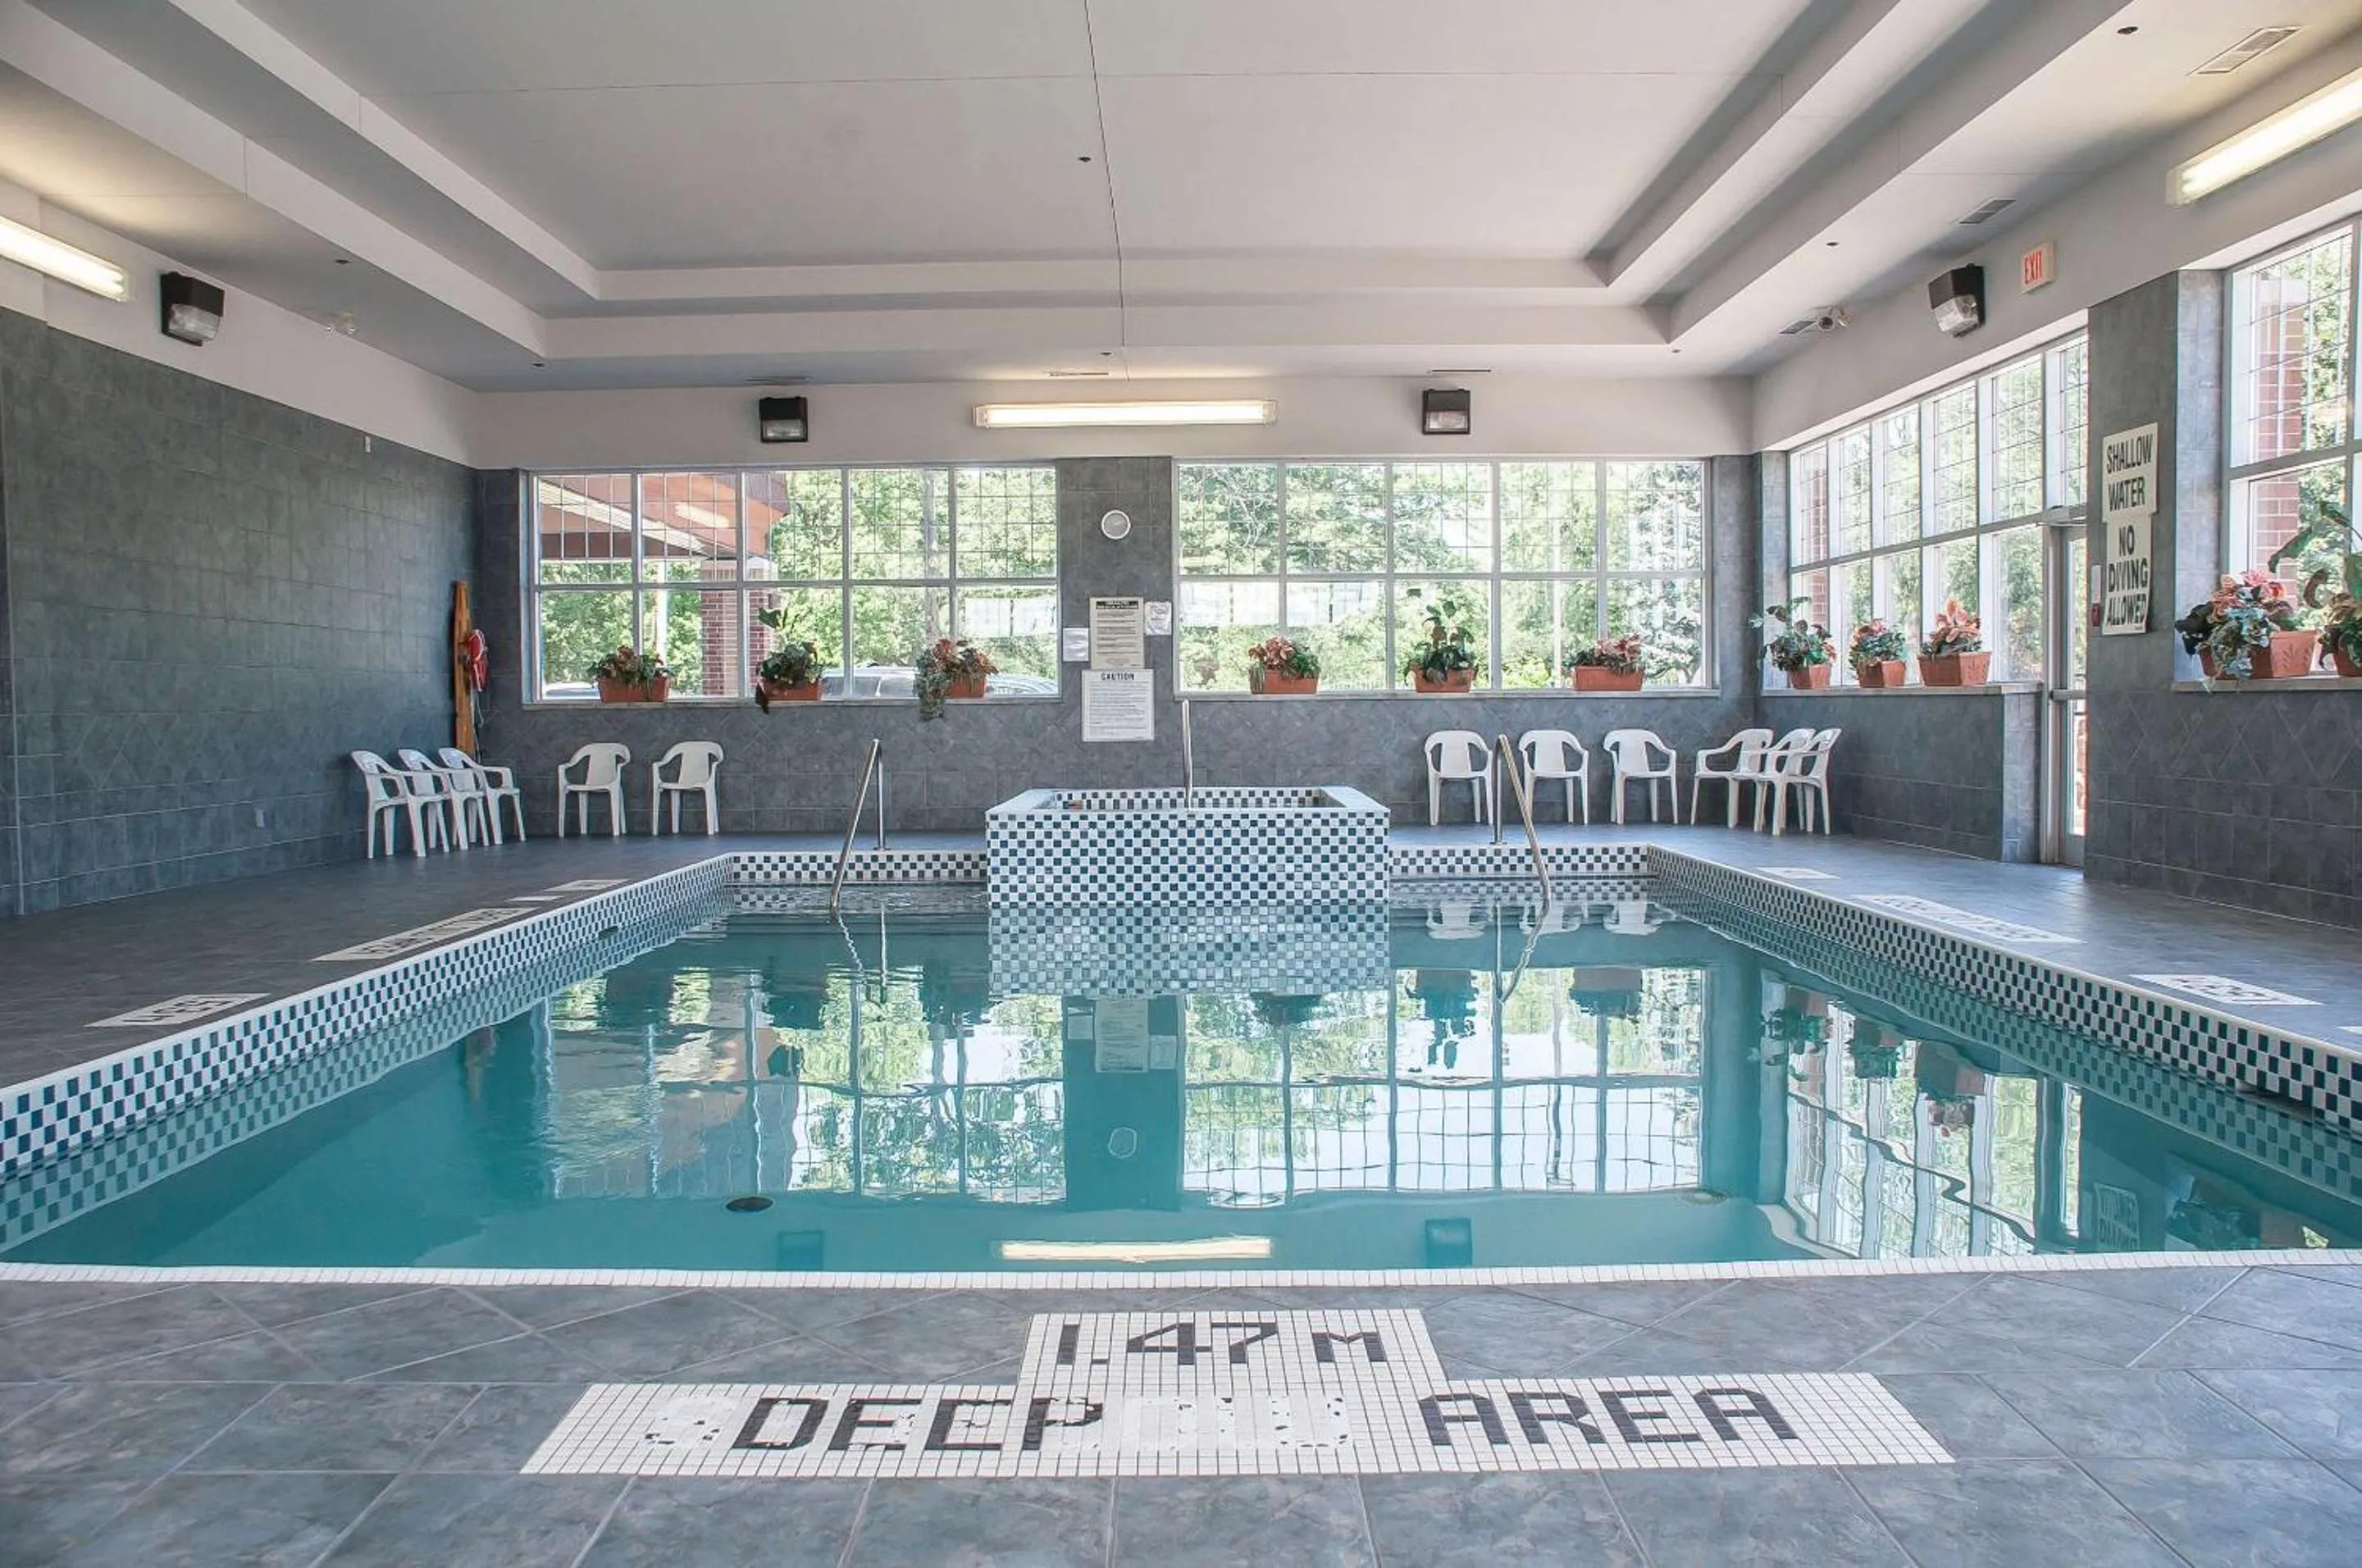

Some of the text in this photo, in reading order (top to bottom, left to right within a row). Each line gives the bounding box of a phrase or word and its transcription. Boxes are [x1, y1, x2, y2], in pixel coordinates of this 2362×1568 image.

[2024, 250, 2043, 285] EXIT
[2106, 433, 2154, 474] SHALLOW
[2108, 476, 2145, 512] WATER
[2118, 525, 2135, 556] NO
[2108, 558, 2149, 593] DIVING
[2106, 593, 2147, 627] ALLOWED
[1100, 672, 1135, 681] CAUTION
[1311, 1330, 1388, 1363] M
[1418, 1388, 1800, 1446] AREA
